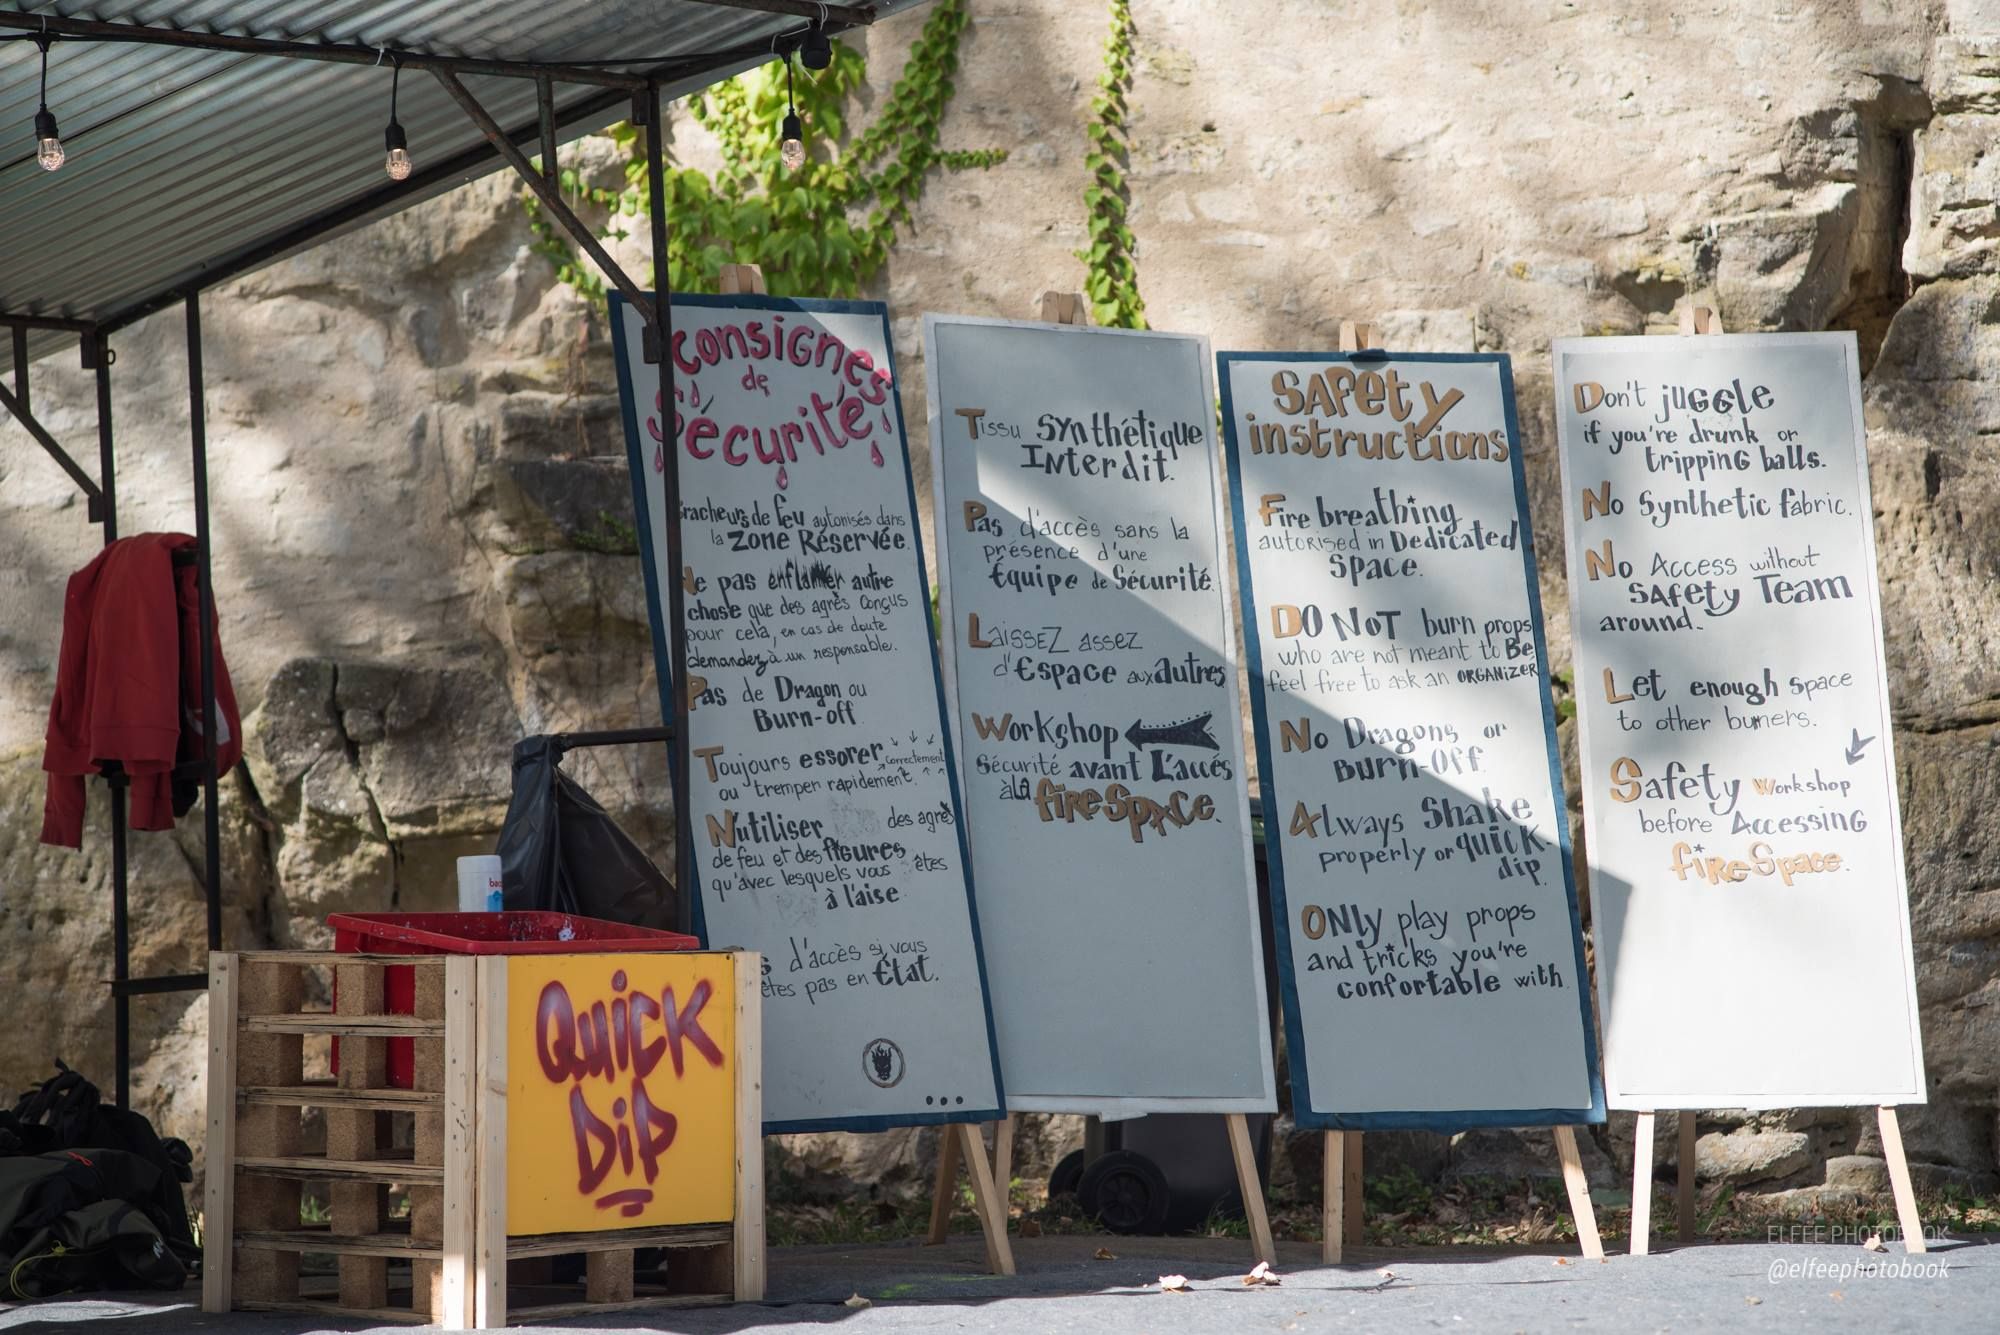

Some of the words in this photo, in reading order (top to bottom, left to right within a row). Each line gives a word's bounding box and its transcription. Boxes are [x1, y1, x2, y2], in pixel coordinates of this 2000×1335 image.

[741, 365, 771, 396] de
[1573, 379, 1648, 415] Don't
[954, 407, 1022, 440] Tissu
[1245, 412, 1511, 463] instructions
[1583, 419, 1601, 444] if
[1609, 425, 1678, 455] you're
[1689, 417, 1760, 444] drunk
[1777, 428, 1798, 442] or
[1760, 445, 1827, 473] balls.
[680, 496, 750, 529] racheurs
[751, 500, 770, 527] de
[774, 493, 805, 529] feu
[876, 503, 906, 527] dans
[1258, 493, 1311, 529] Fire
[1315, 486, 1463, 536] breathing
[1582, 480, 1624, 521] No
[1778, 487, 1853, 519] fabric.
[963, 500, 1003, 538] Pas
[1020, 506, 1101, 540] d'accès
[1114, 524, 1159, 540] sans
[1171, 516, 1190, 541] la
[711, 528, 724, 546] la
[727, 529, 790, 552] Zone
[983, 540, 1080, 564] présence
[1098, 541, 1149, 562] d'une
[1369, 531, 1385, 551] in
[988, 556, 1079, 596] Équipe
[1091, 571, 1109, 590] de
[1585, 538, 1634, 581] No
[1650, 552, 1738, 578] Access
[1750, 544, 1821, 571] without
[717, 572, 757, 608] pas
[851, 562, 894, 591] autre
[1753, 573, 1854, 605] Team
[687, 599, 743, 622] chose
[748, 601, 774, 626] que
[780, 596, 805, 616] des
[812, 590, 851, 619] agrès
[685, 627, 724, 653] pour
[781, 629, 795, 639] en
[801, 625, 823, 636] cas
[827, 619, 844, 635] de
[851, 615, 887, 633] doute
[1421, 607, 1477, 639] burn
[1484, 618, 1533, 649] props
[686, 645, 768, 677] demandez
[770, 649, 783, 664] à
[784, 651, 806, 662] un
[1278, 638, 1322, 667] who
[1331, 650, 1366, 666] are
[1373, 642, 1403, 666] not
[1409, 637, 1473, 665] meant
[1479, 641, 1501, 661] to
[686, 672, 728, 711] Pas
[742, 675, 764, 704] de
[774, 674, 842, 708] Dragon
[849, 682, 868, 699] ou
[1127, 669, 1153, 687] aux
[1267, 667, 1306, 693] feel
[1314, 667, 1357, 694] free
[1361, 665, 1381, 691] to
[1388, 668, 1422, 689] ask
[1424, 671, 1450, 688] an
[1602, 666, 1667, 705] Let
[1690, 668, 1780, 706] enough
[971, 709, 1119, 760] Workshop
[1279, 716, 1329, 754] No
[1343, 716, 1459, 756] Dragons
[1483, 722, 1508, 740] or
[1617, 708, 1642, 732] to
[1655, 704, 1711, 731] other
[692, 744, 791, 788] Toujours
[799, 742, 884, 769] essorer
[976, 751, 1062, 776] Sécurité
[1069, 750, 1143, 781] avant
[719, 789, 740, 802] ou
[754, 783, 822, 802] tremper
[1609, 756, 1741, 816] Safety
[1752, 767, 1852, 798] Workshop
[887, 805, 914, 829] des
[1289, 800, 1405, 848] Always
[1421, 786, 1534, 832] Shake
[1638, 807, 1713, 835] before
[712, 846, 734, 869] de
[737, 846, 765, 869] feu
[772, 846, 792, 867] et
[795, 842, 823, 865] des
[1319, 838, 1427, 876] properly
[1434, 848, 1455, 862] or
[712, 871, 775, 903] qu'avec
[784, 864, 852, 893] lesquels
[856, 864, 892, 880] vous
[911, 851, 949, 873] êtes
[824, 888, 839, 911] à
[1397, 899, 1449, 948] play
[1466, 903, 1536, 943] props
[790, 935, 862, 973] d'accès
[869, 938, 884, 956] si
[889, 940, 928, 956] vous
[1307, 945, 1353, 973] and
[1362, 938, 1438, 976] tricks
[1451, 941, 1528, 974] you're
[761, 975, 797, 999] êtes
[805, 977, 838, 1006] pas
[847, 973, 869, 987] en
[1337, 967, 1501, 1000] confortable
